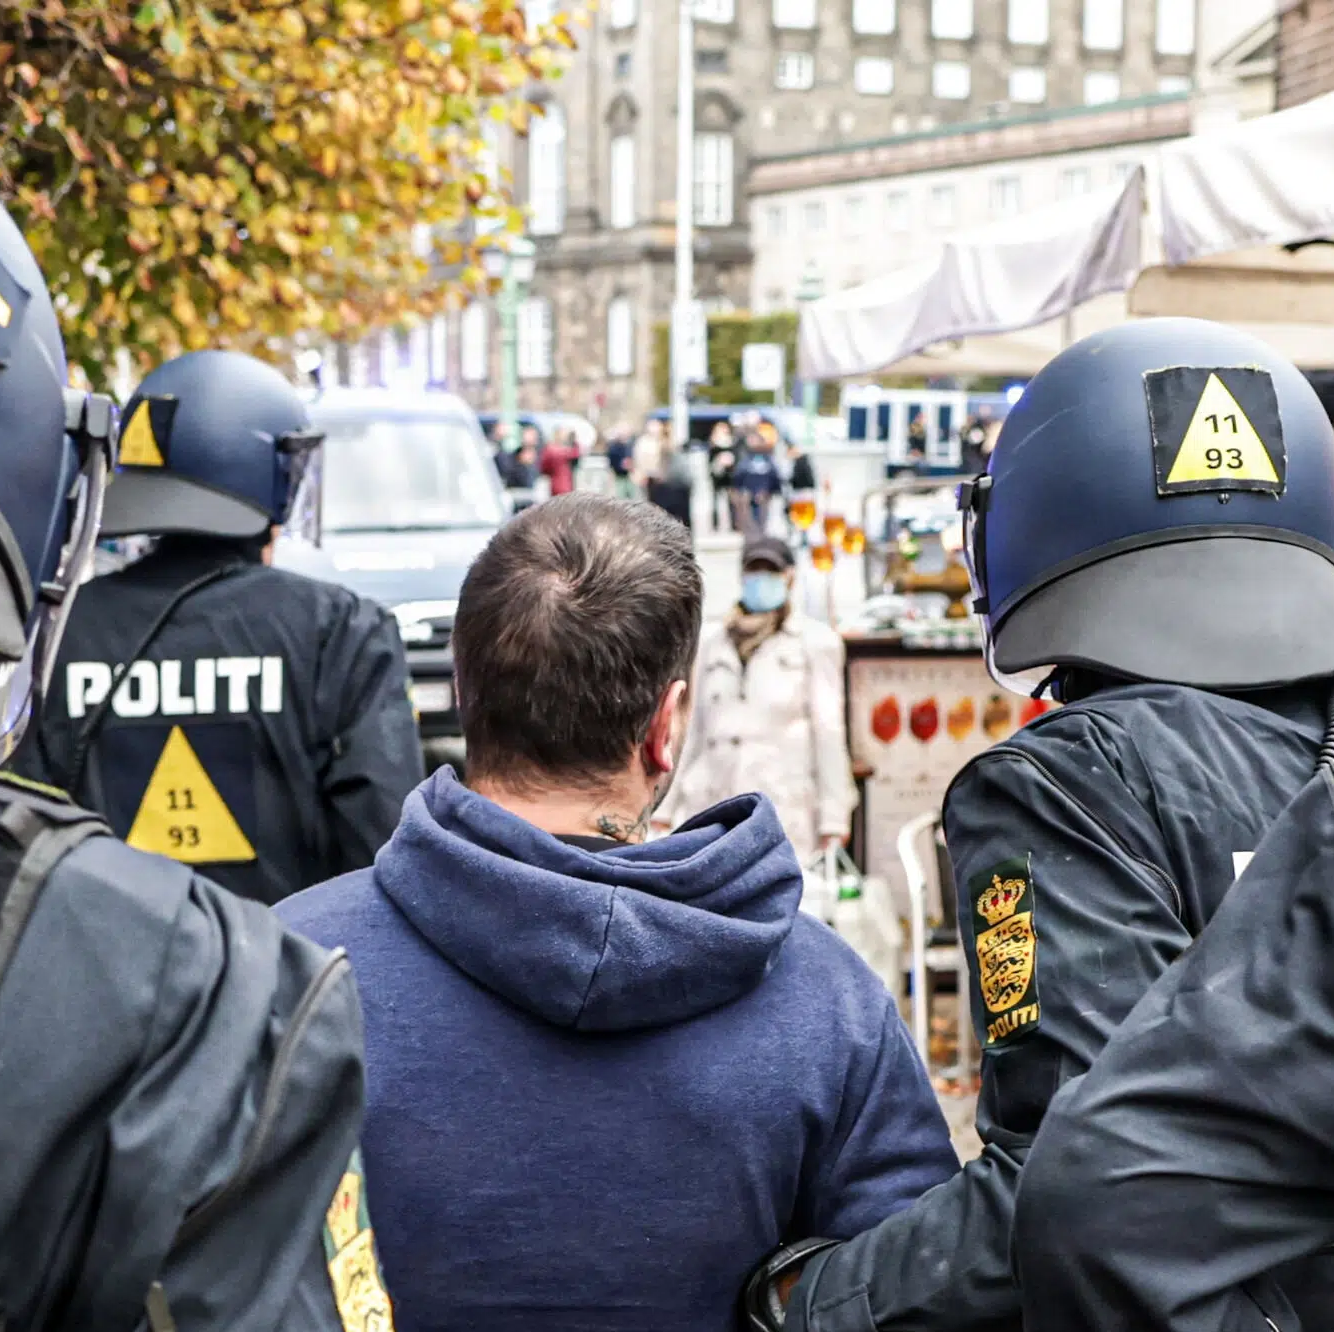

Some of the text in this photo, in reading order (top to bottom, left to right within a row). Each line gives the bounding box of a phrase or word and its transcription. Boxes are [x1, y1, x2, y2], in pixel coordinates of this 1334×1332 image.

[1204, 414, 1238, 433] 11
[1205, 448, 1244, 469] 93
[67, 656, 283, 718] POLITI
[167, 788, 197, 810] 11
[168, 825, 201, 847] 93
[987, 1002, 1038, 1044] POLITI
